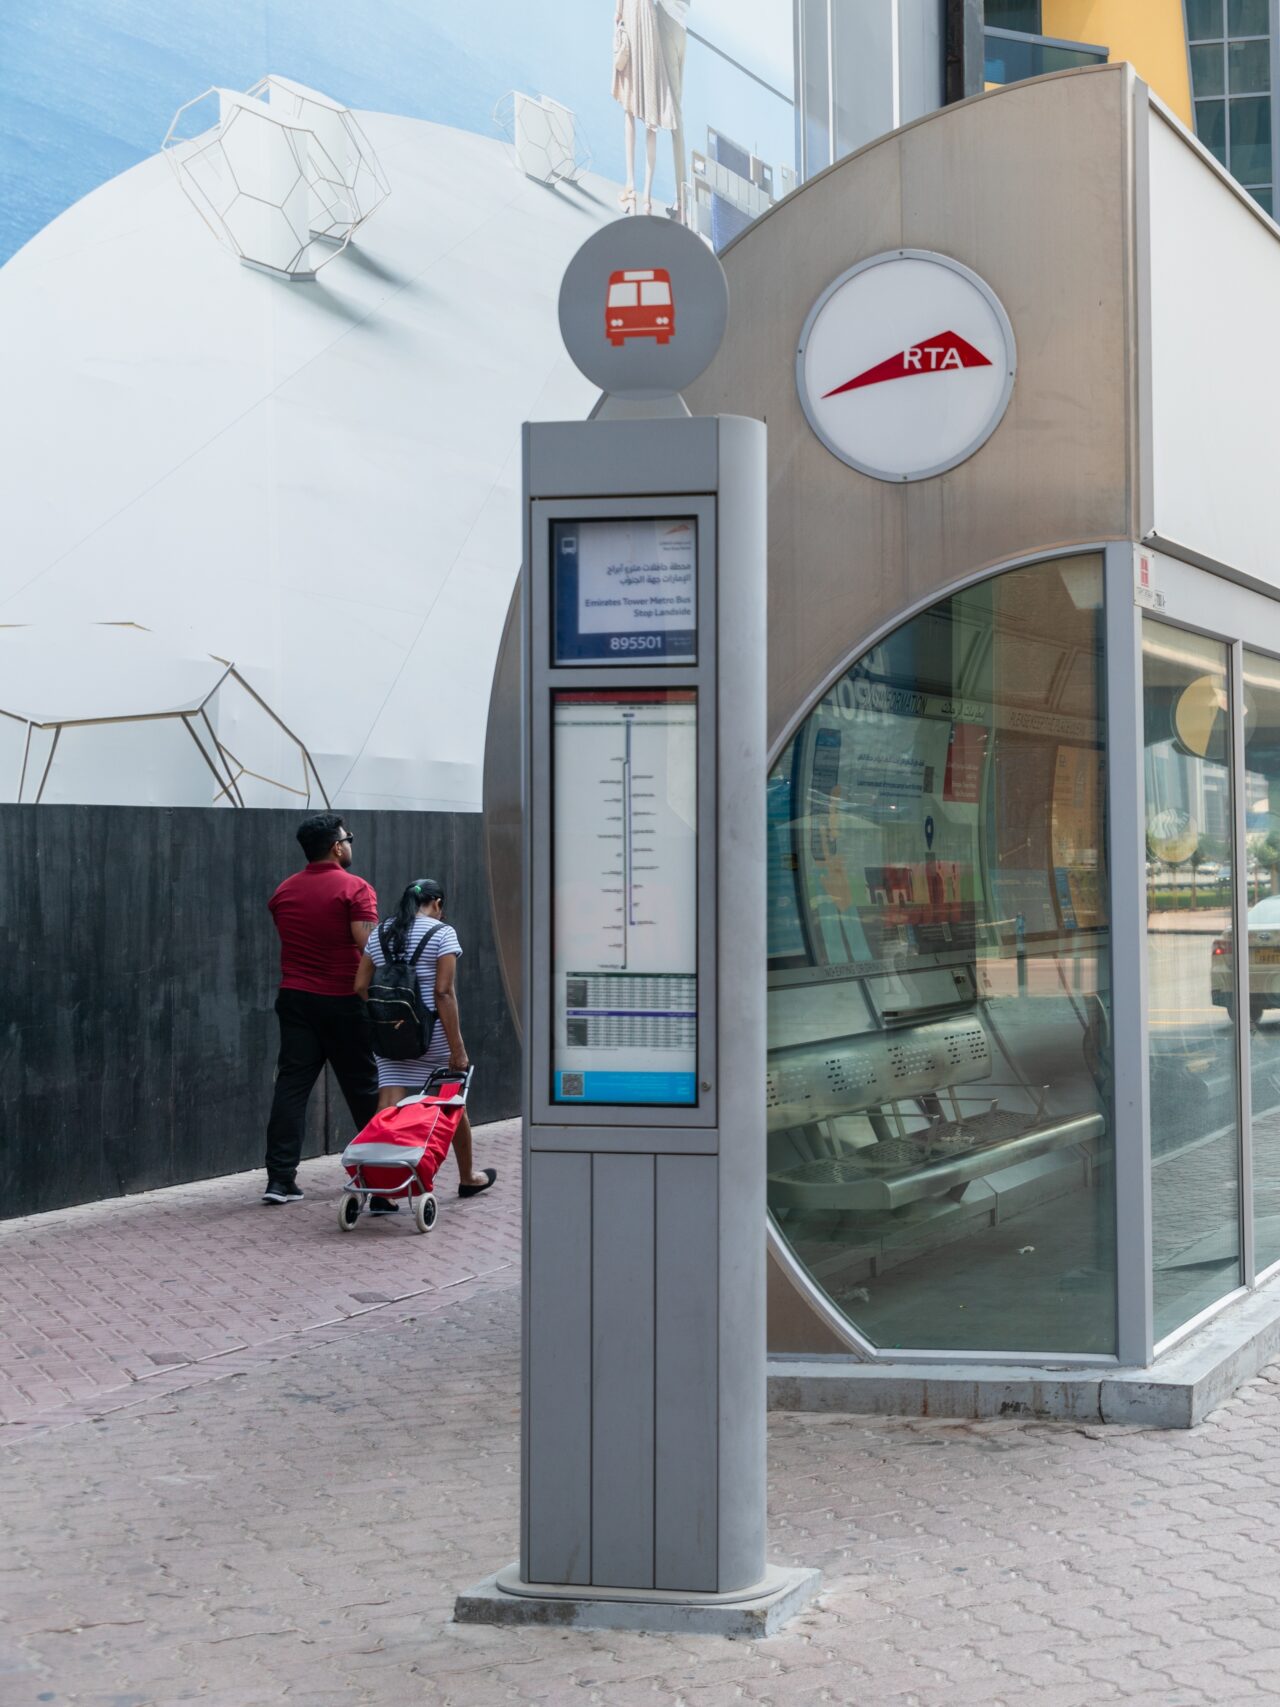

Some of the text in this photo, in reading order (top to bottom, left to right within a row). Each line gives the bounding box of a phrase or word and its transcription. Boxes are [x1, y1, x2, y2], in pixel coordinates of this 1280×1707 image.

[903, 347, 964, 369] RTA
[585, 596, 691, 607] Emirates Tower Metro Bus
[633, 608, 691, 618] Stop Landside
[610, 636, 662, 650] 895501
